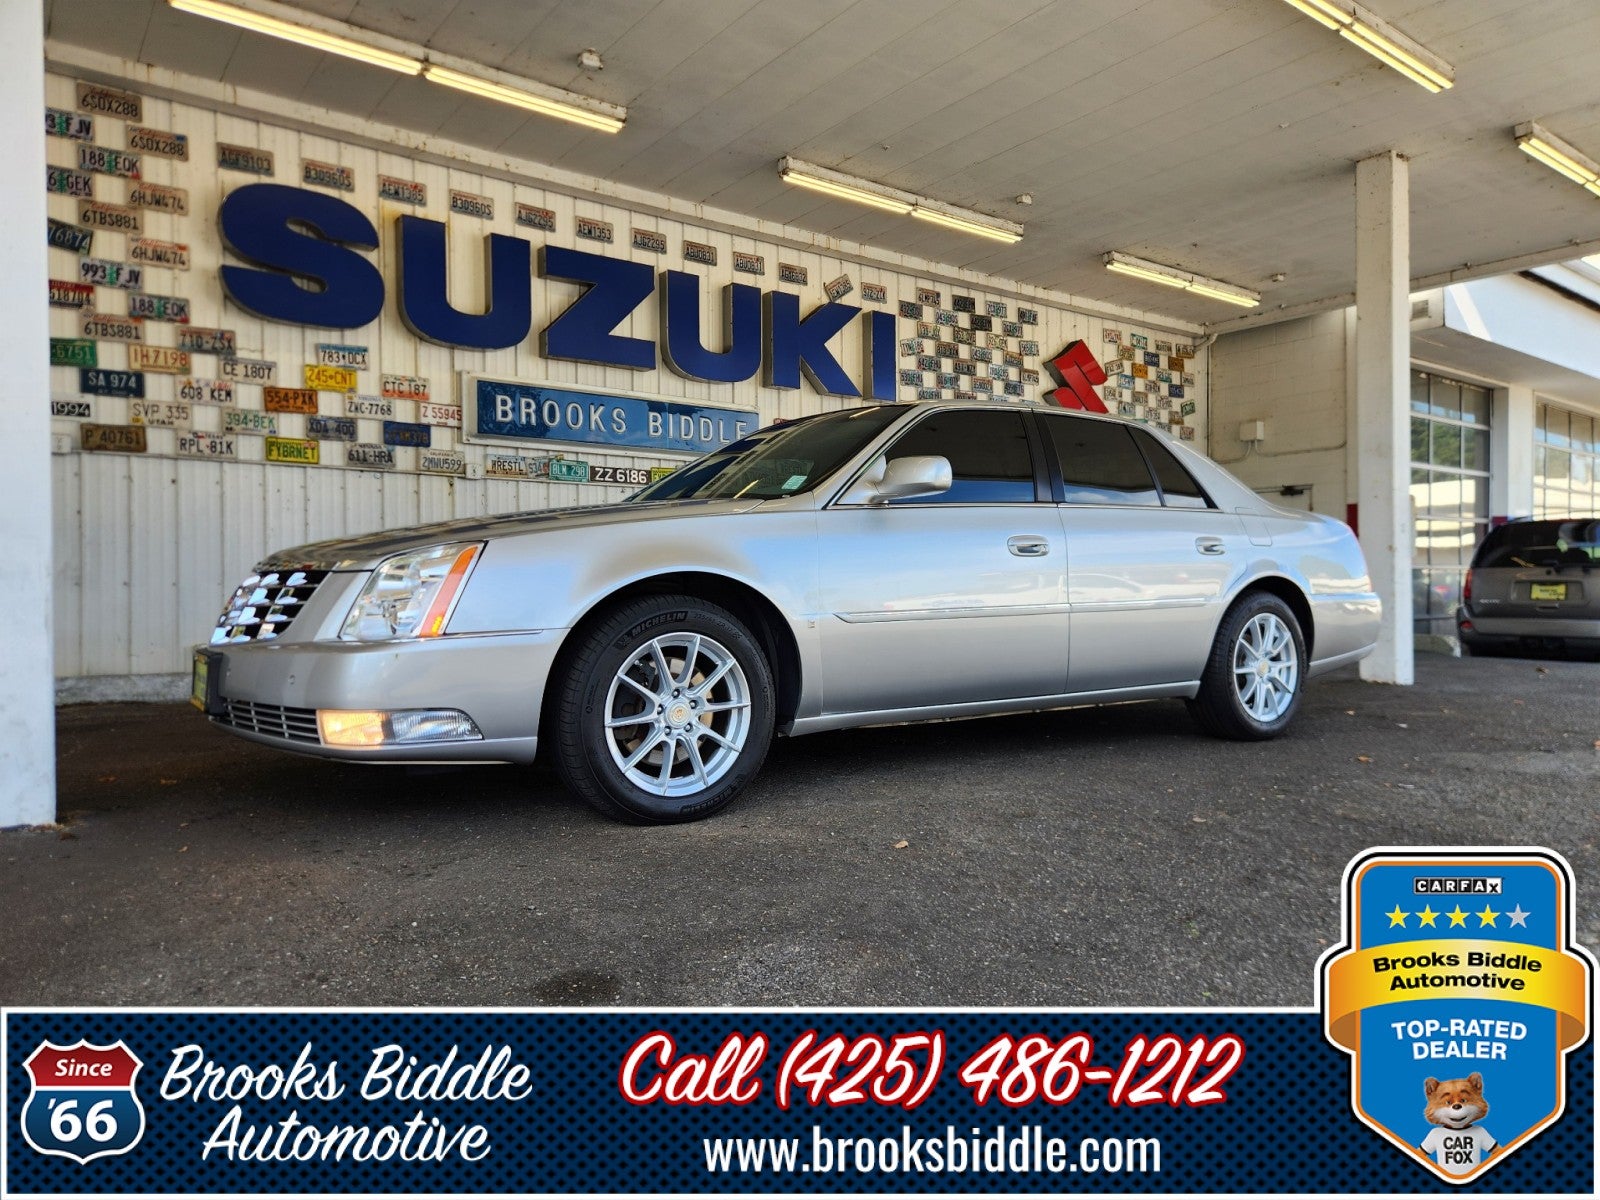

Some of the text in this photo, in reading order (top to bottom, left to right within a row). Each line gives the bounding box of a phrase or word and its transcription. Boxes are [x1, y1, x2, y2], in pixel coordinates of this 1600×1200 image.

[220, 181, 897, 402] SUZUKI
[223, 362, 272, 380] CE 1807
[110, 374, 136, 388] 974
[383, 381, 427, 396] CTC 187
[180, 387, 203, 401] 608
[52, 401, 90, 417] 1994
[132, 403, 189, 421] SVP 335
[422, 405, 429, 418] Z
[494, 394, 749, 445] BROOKS BIDDLE
[595, 467, 614, 482] ZZ
[616, 470, 648, 484] 6186
[631, 611, 686, 637] MICHELIN
